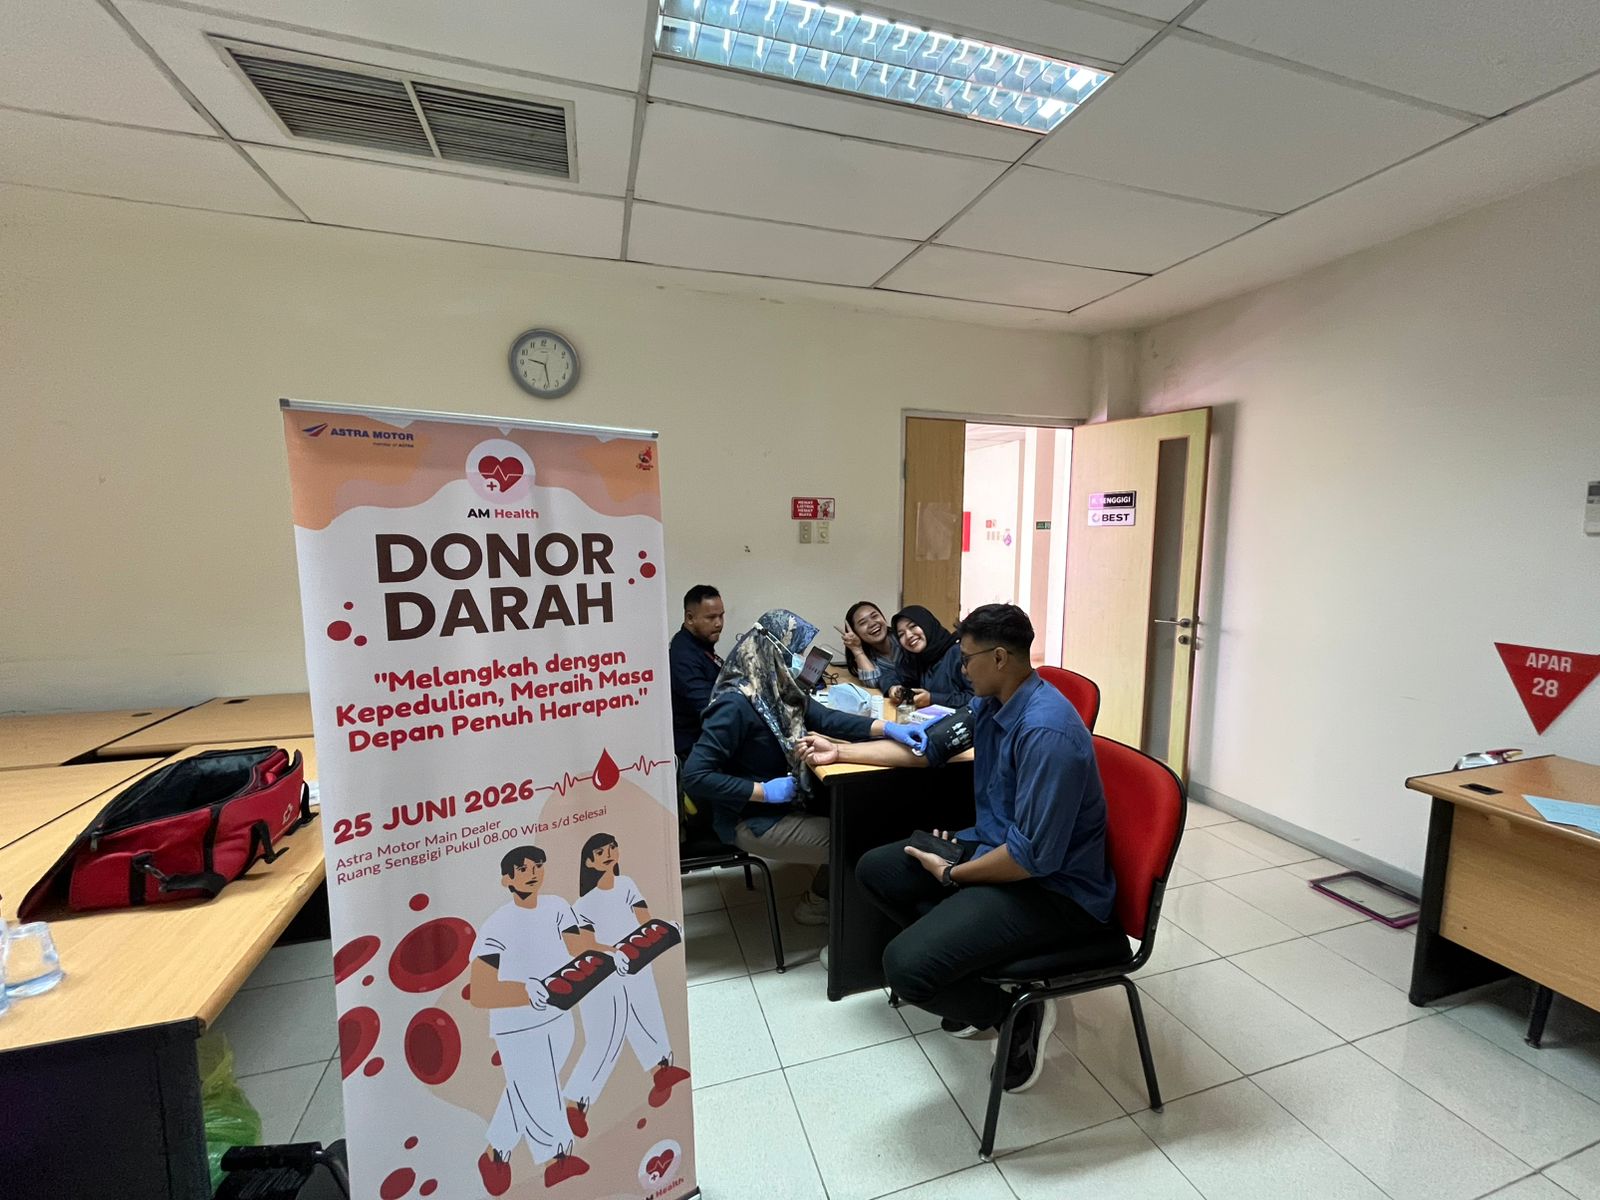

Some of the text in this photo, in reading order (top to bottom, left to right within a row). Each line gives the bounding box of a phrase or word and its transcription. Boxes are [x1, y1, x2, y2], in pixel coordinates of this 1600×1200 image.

[330, 428, 415, 442] ASTRA MOTOR
[467, 508, 540, 519] AM Health
[1102, 513, 1130, 521] BEST
[375, 532, 615, 584] DONOR
[384, 581, 614, 642] DARAH
[374, 651, 626, 693] "Melangkah dengan
[1525, 652, 1573, 673] APAR
[336, 669, 654, 728] Kepedulian, Meraih Masa
[1531, 677, 1559, 698] 28
[348, 687, 648, 753] Depan Penuh Harapan."
[333, 779, 534, 845] 25 JUNI 2026
[336, 819, 502, 871] Astra Motor Main Dealer
[337, 805, 607, 886] Ruang Senggigi Pukul 08.00 Wita s/d Selesai
[655, 1178, 684, 1197] Health
